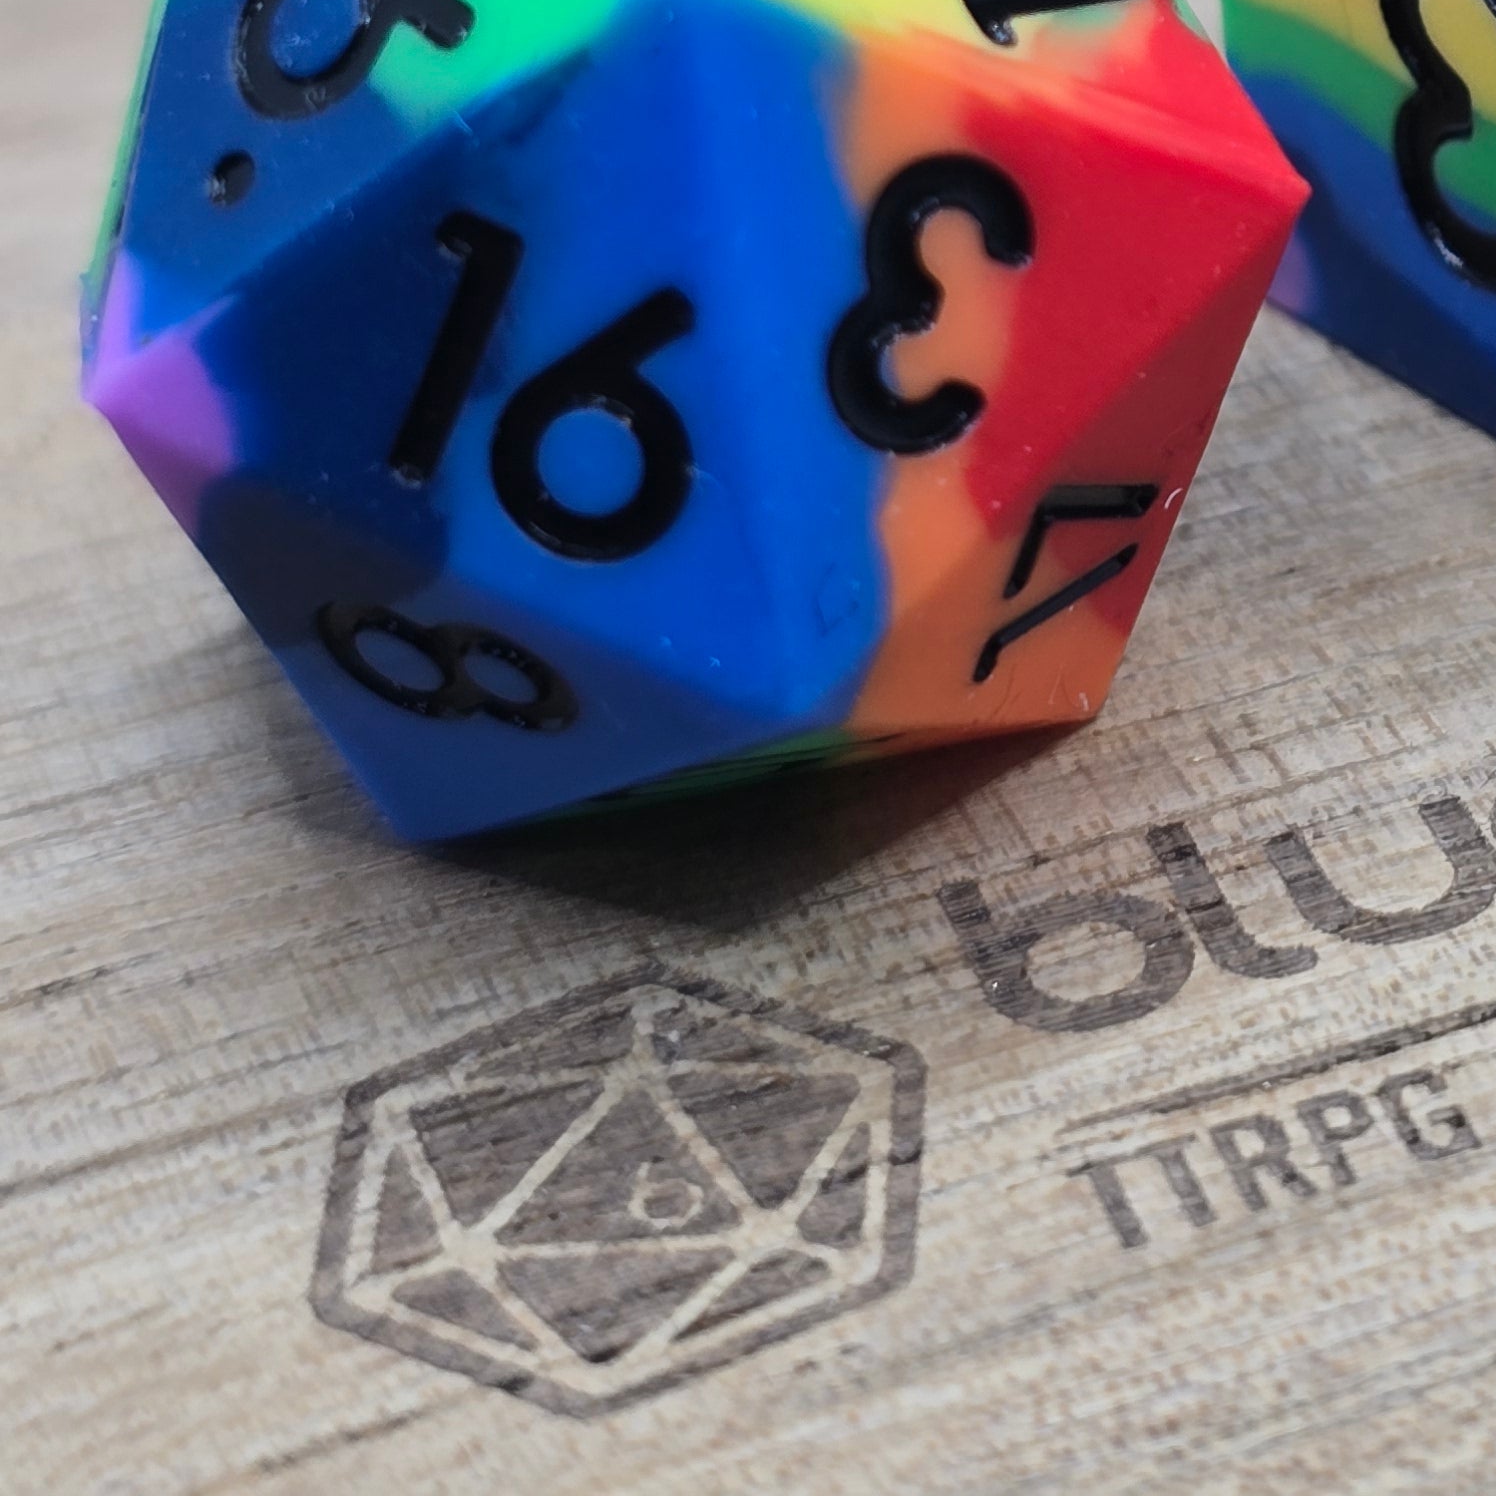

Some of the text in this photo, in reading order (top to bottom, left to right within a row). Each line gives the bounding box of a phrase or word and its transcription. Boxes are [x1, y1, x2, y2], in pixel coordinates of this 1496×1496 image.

[386, 208, 697, 564] 16
[826, 149, 1036, 457] 3
[315, 599, 582, 735] 8
[1065, 1067, 1483, 1251] TTRPG
